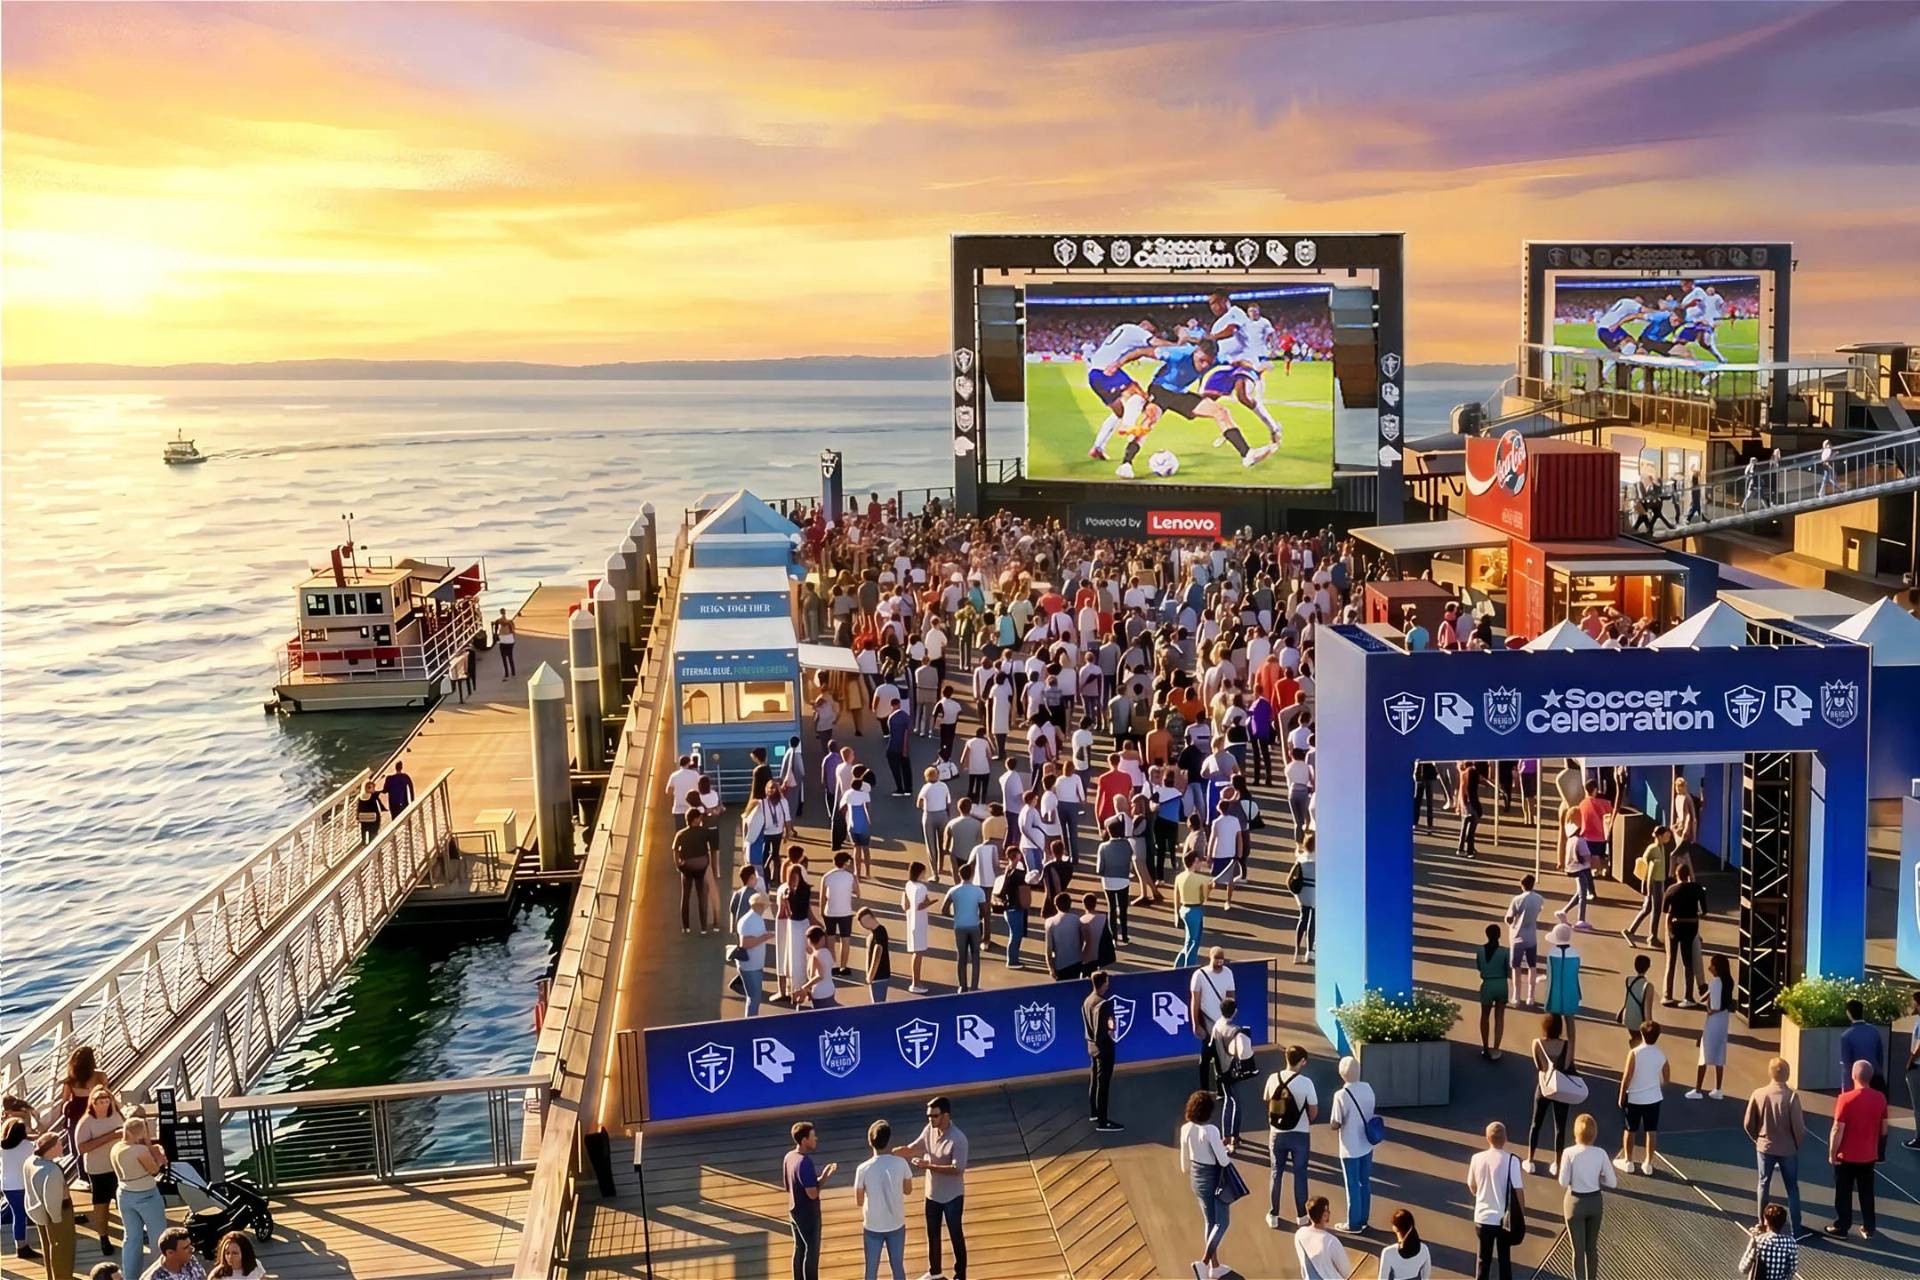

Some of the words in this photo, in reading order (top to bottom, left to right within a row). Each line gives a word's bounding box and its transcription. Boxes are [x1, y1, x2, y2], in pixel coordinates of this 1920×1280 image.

[1085, 517, 1127, 527] Powered
[1128, 517, 1142, 528] by
[1152, 516, 1215, 531] Lenovo
[728, 603, 771, 613] TOGETHER
[682, 667, 712, 676] ETERNAL
[1564, 688, 1678, 709] Soccer
[1525, 707, 1715, 734] Celebration
